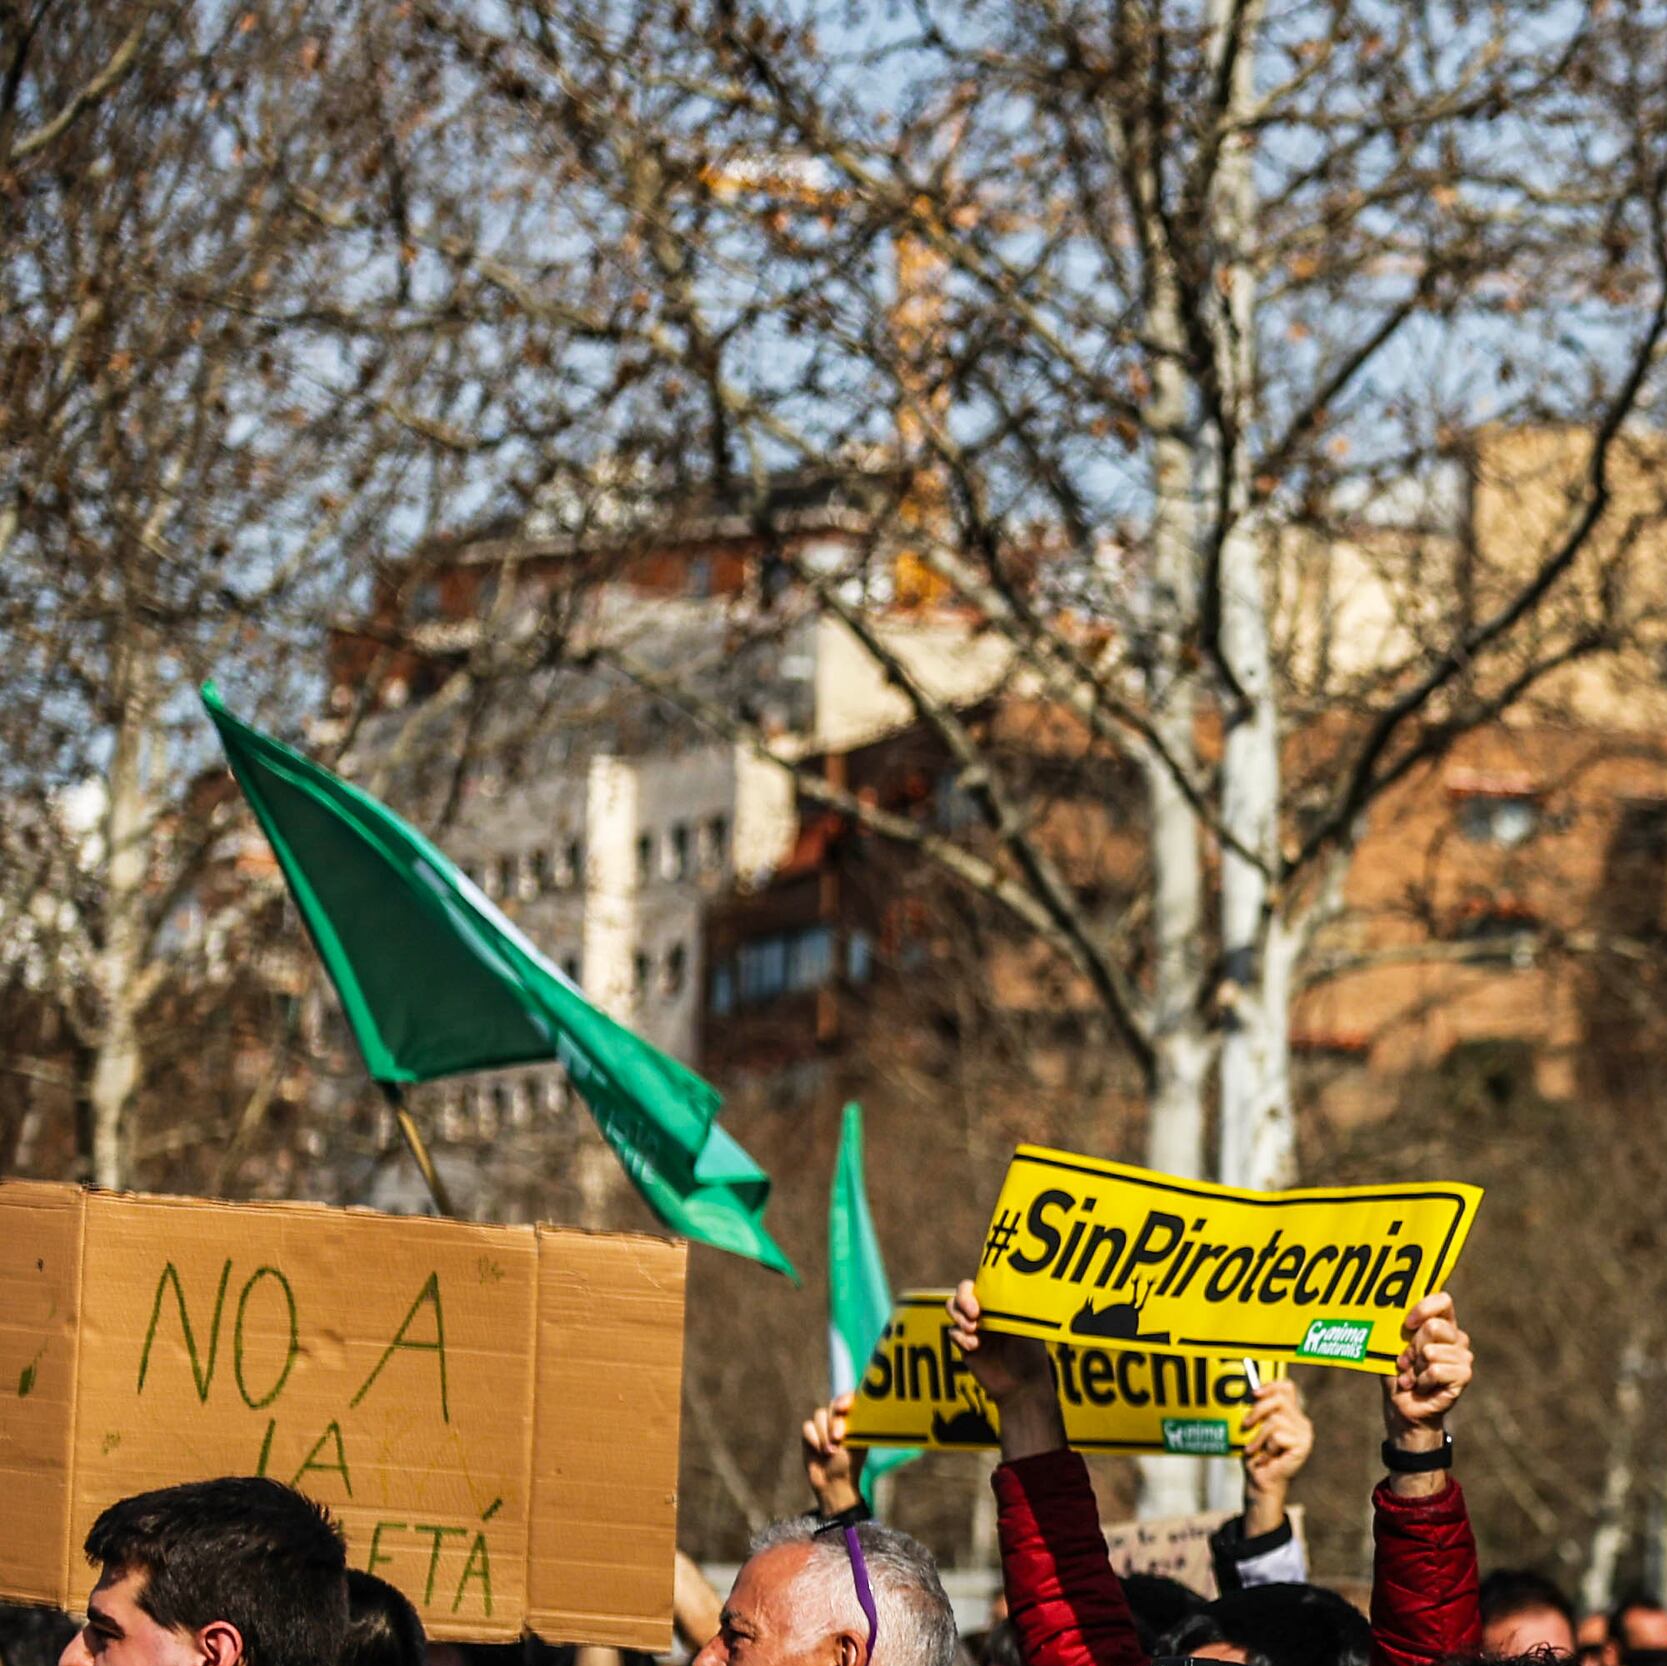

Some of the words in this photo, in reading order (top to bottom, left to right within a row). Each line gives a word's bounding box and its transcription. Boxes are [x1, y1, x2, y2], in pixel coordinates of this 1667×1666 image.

[982, 1188, 1424, 1310] #SinPirotecnia
[136, 1257, 299, 1411] NO
[349, 1270, 451, 1425] A
